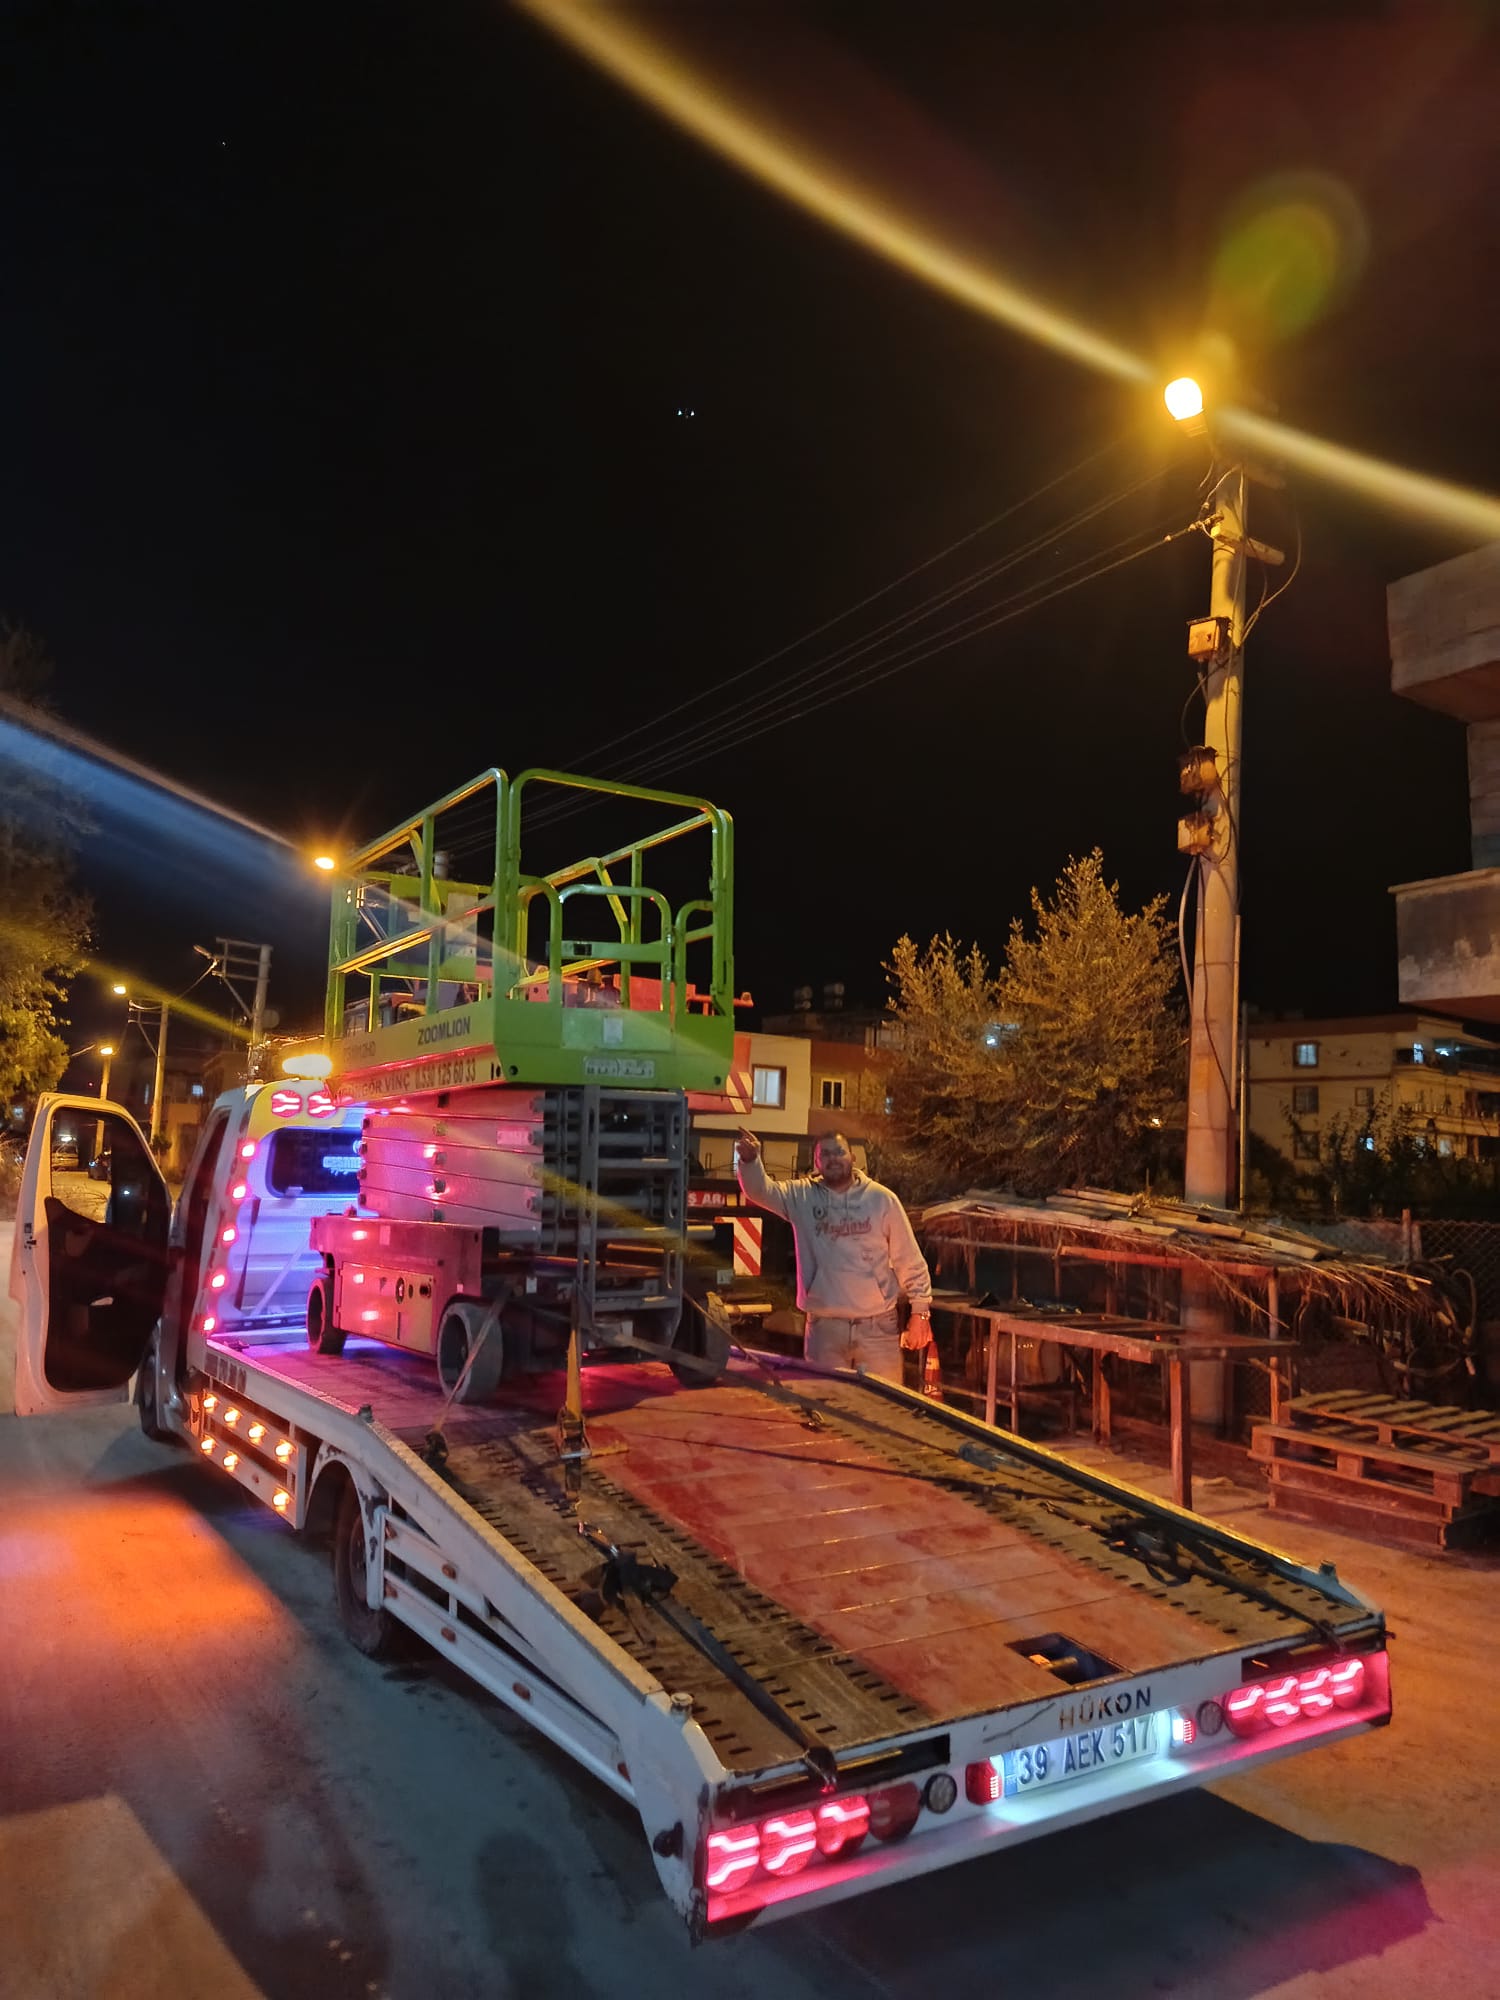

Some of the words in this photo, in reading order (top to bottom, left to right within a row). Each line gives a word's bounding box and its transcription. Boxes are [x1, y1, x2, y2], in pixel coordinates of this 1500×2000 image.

[417, 1016, 471, 1046] ZOOMLION
[466, 1056, 476, 1082] 33
[1058, 1686, 1151, 1731] HÜKON
[1017, 1746, 1048, 1785] 39
[1063, 1728, 1106, 1774] AEK
[1112, 1716, 1153, 1758] 517
